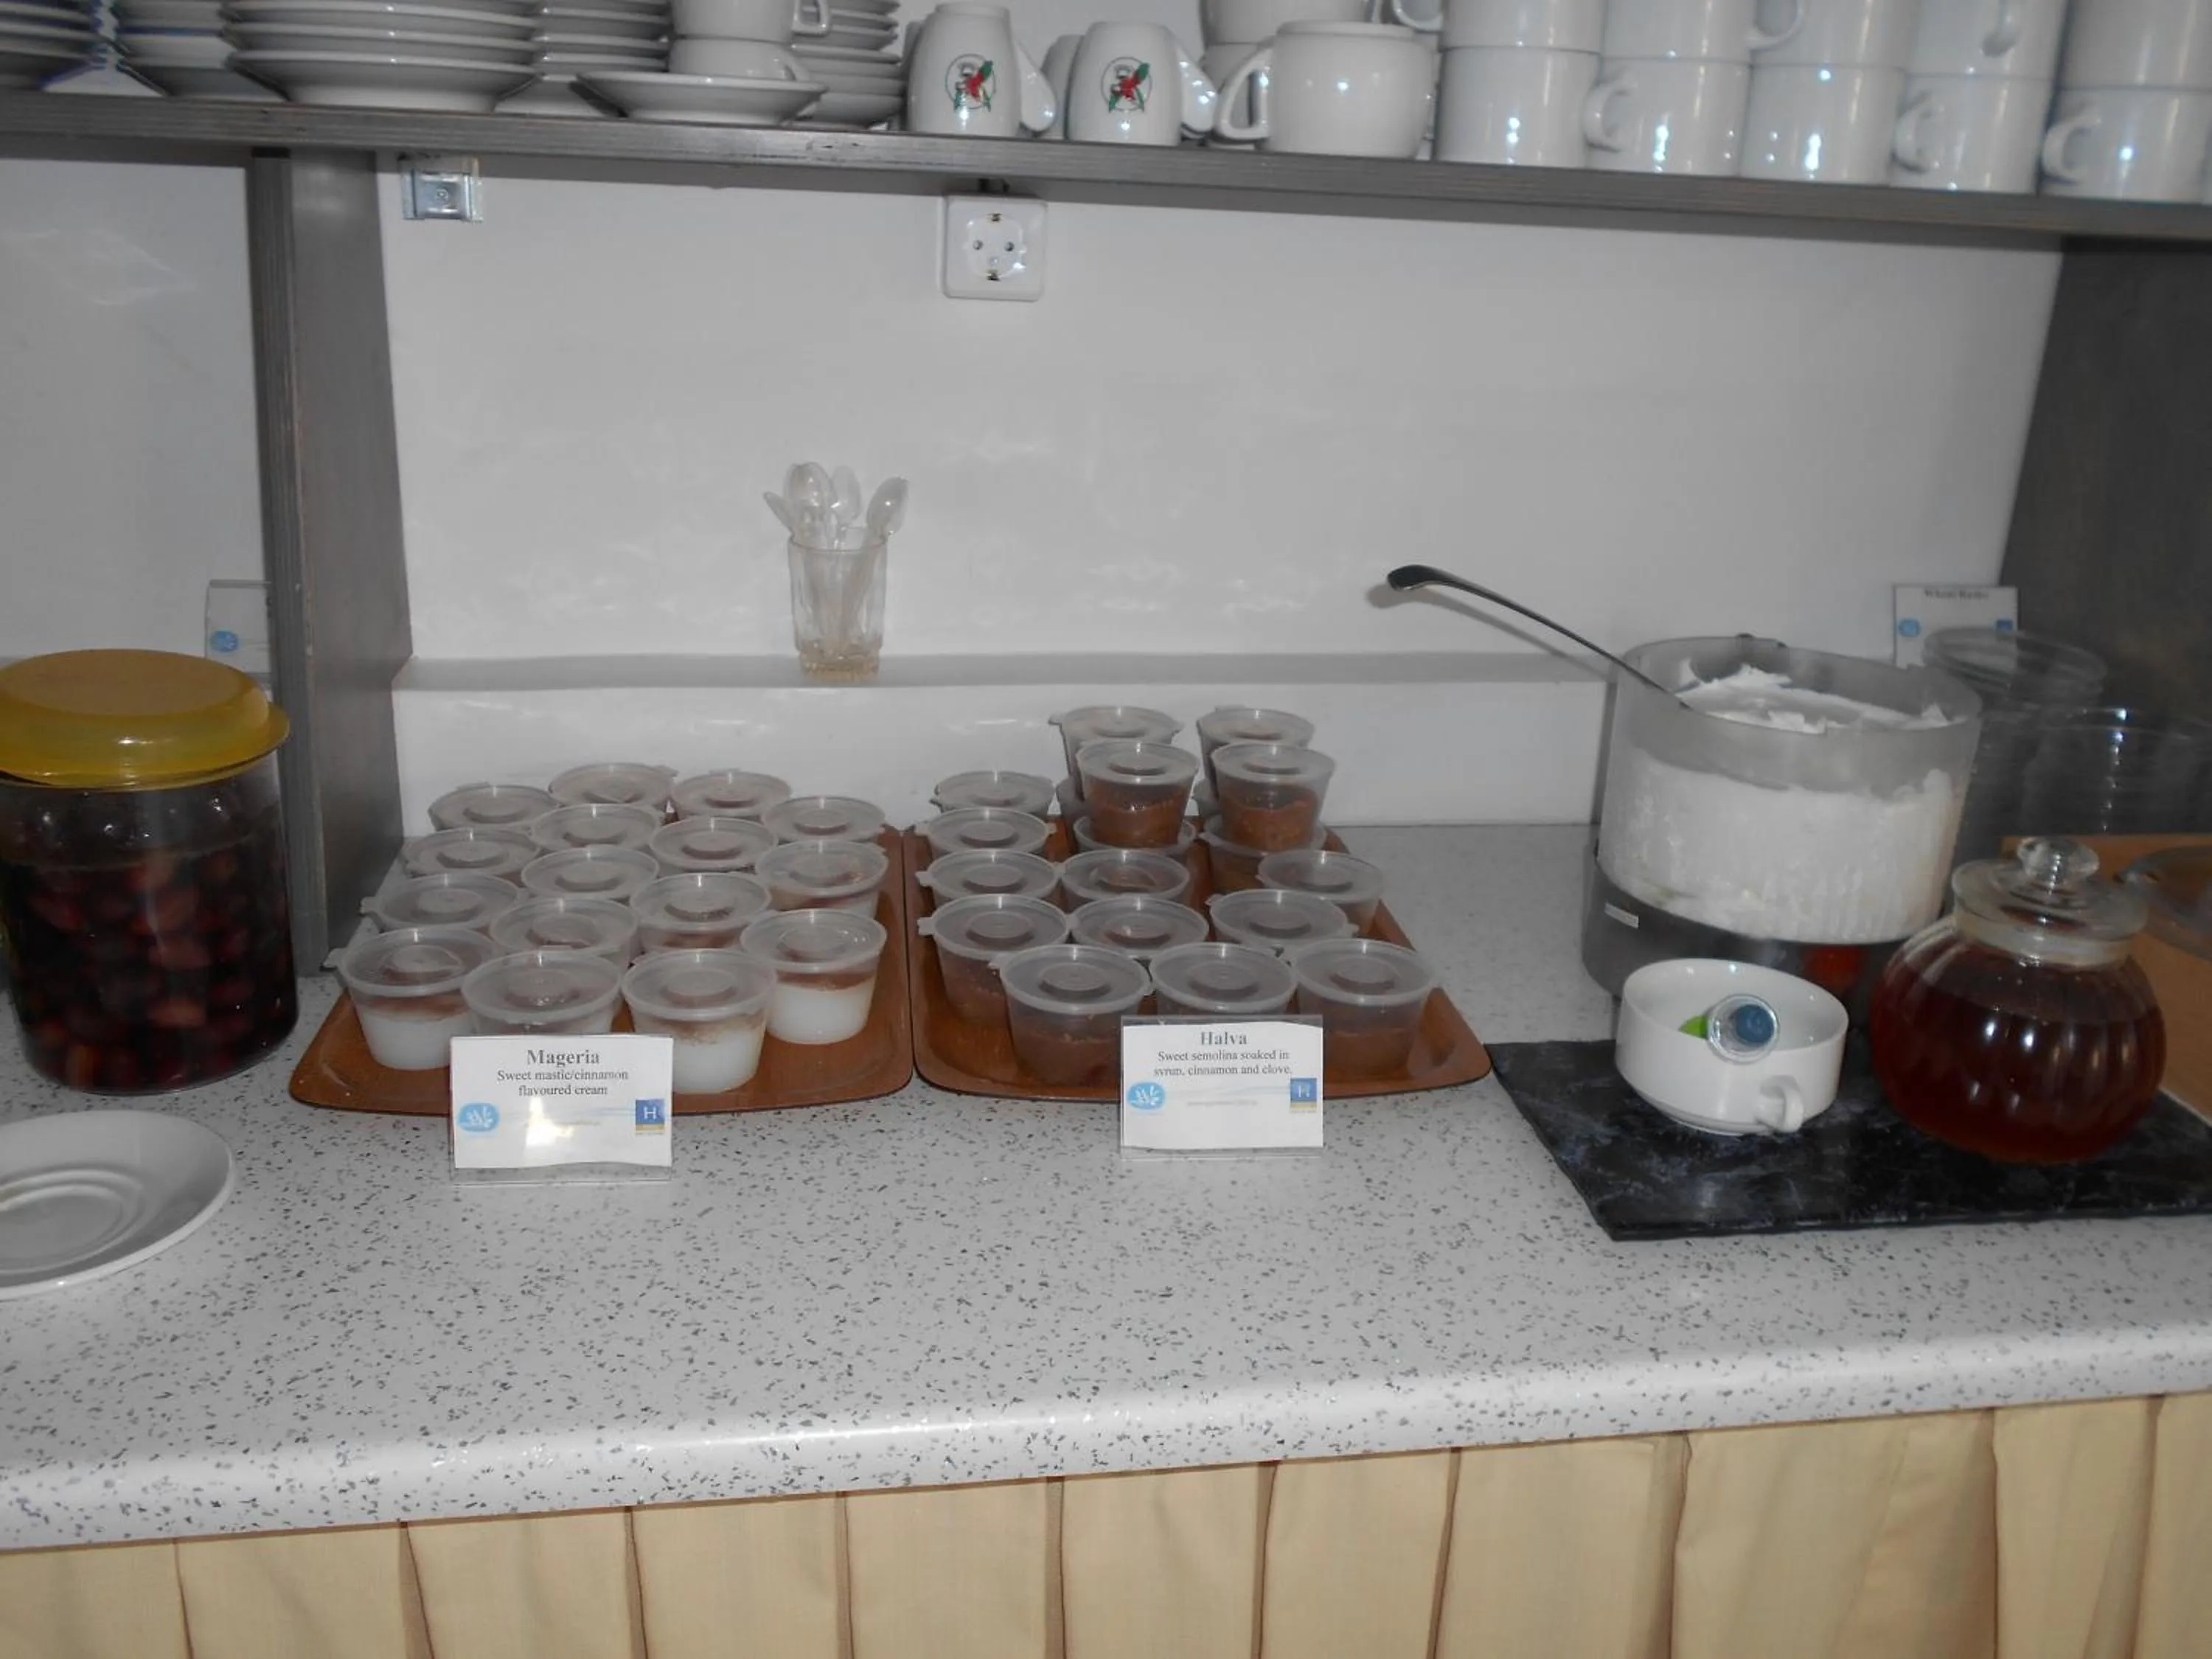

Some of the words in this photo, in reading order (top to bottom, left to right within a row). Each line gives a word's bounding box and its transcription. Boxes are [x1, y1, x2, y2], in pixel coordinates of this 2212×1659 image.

[1200, 1032, 1247, 1046] Halva
[527, 1049, 599, 1066] Mageria
[1158, 1051, 1189, 1062] Sweet
[1192, 1050, 1238, 1061] semolina
[1240, 1049, 1276, 1060] soaked
[1279, 1050, 1290, 1060] in
[497, 1070, 532, 1081] Sweet
[535, 1069, 628, 1081] mastic/cinnamon
[1188, 1065, 1238, 1075] cinnamon
[1241, 1065, 1259, 1075] and
[518, 1085, 571, 1096] flavoured
[574, 1086, 608, 1096] cream
[643, 1108, 657, 1121] H
